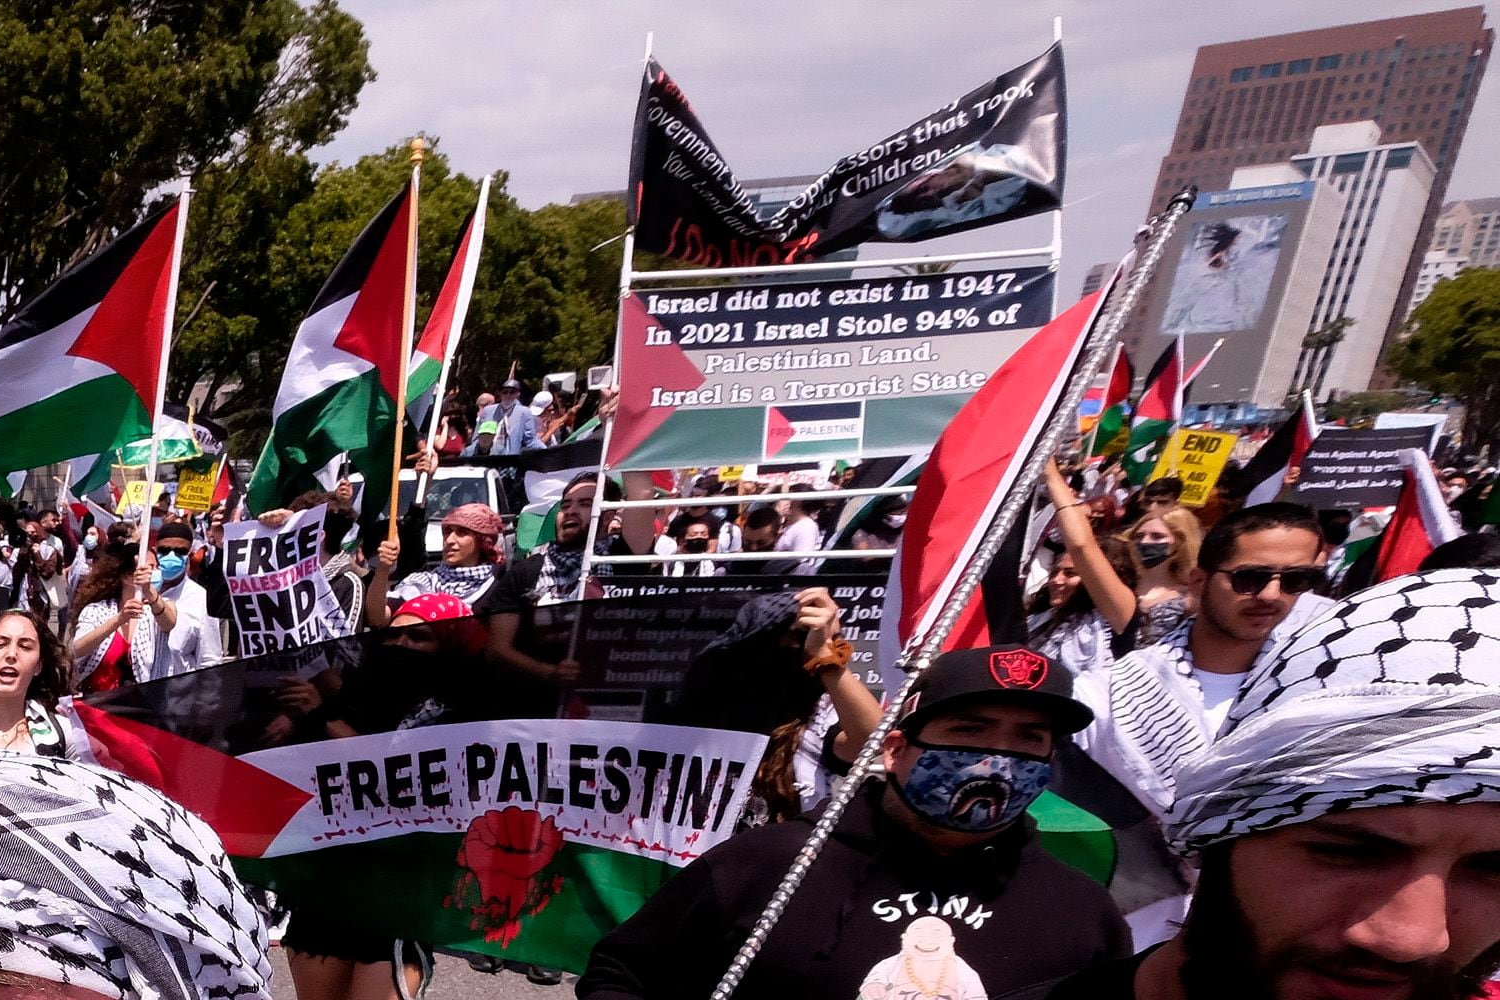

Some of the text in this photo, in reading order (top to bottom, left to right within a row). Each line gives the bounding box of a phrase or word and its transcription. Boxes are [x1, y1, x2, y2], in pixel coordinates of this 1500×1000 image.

[914, 111, 969, 146] that
[972, 78, 1036, 121] Took
[662, 150, 695, 181] Your
[647, 272, 1023, 315] Israel did not exist in 1947.
[645, 302, 1023, 346] In 2021 Israel Stole 94% of
[703, 340, 940, 375] Palestinian Land.
[650, 369, 989, 408] Israel is a Terrorist State
[800, 423, 858, 436] PALESTINE
[1182, 433, 1222, 454] END
[1184, 453, 1204, 465] ALL
[1330, 449, 1368, 461] Against
[1367, 449, 1400, 460] Apart
[227, 520, 320, 577] FREE
[229, 556, 320, 594] PALESTINE!
[602, 585, 634, 599] You
[833, 586, 867, 601] my
[232, 579, 316, 632] END
[241, 615, 321, 656] ISRAELI
[315, 749, 453, 817] FREE
[872, 890, 994, 930] STINK
